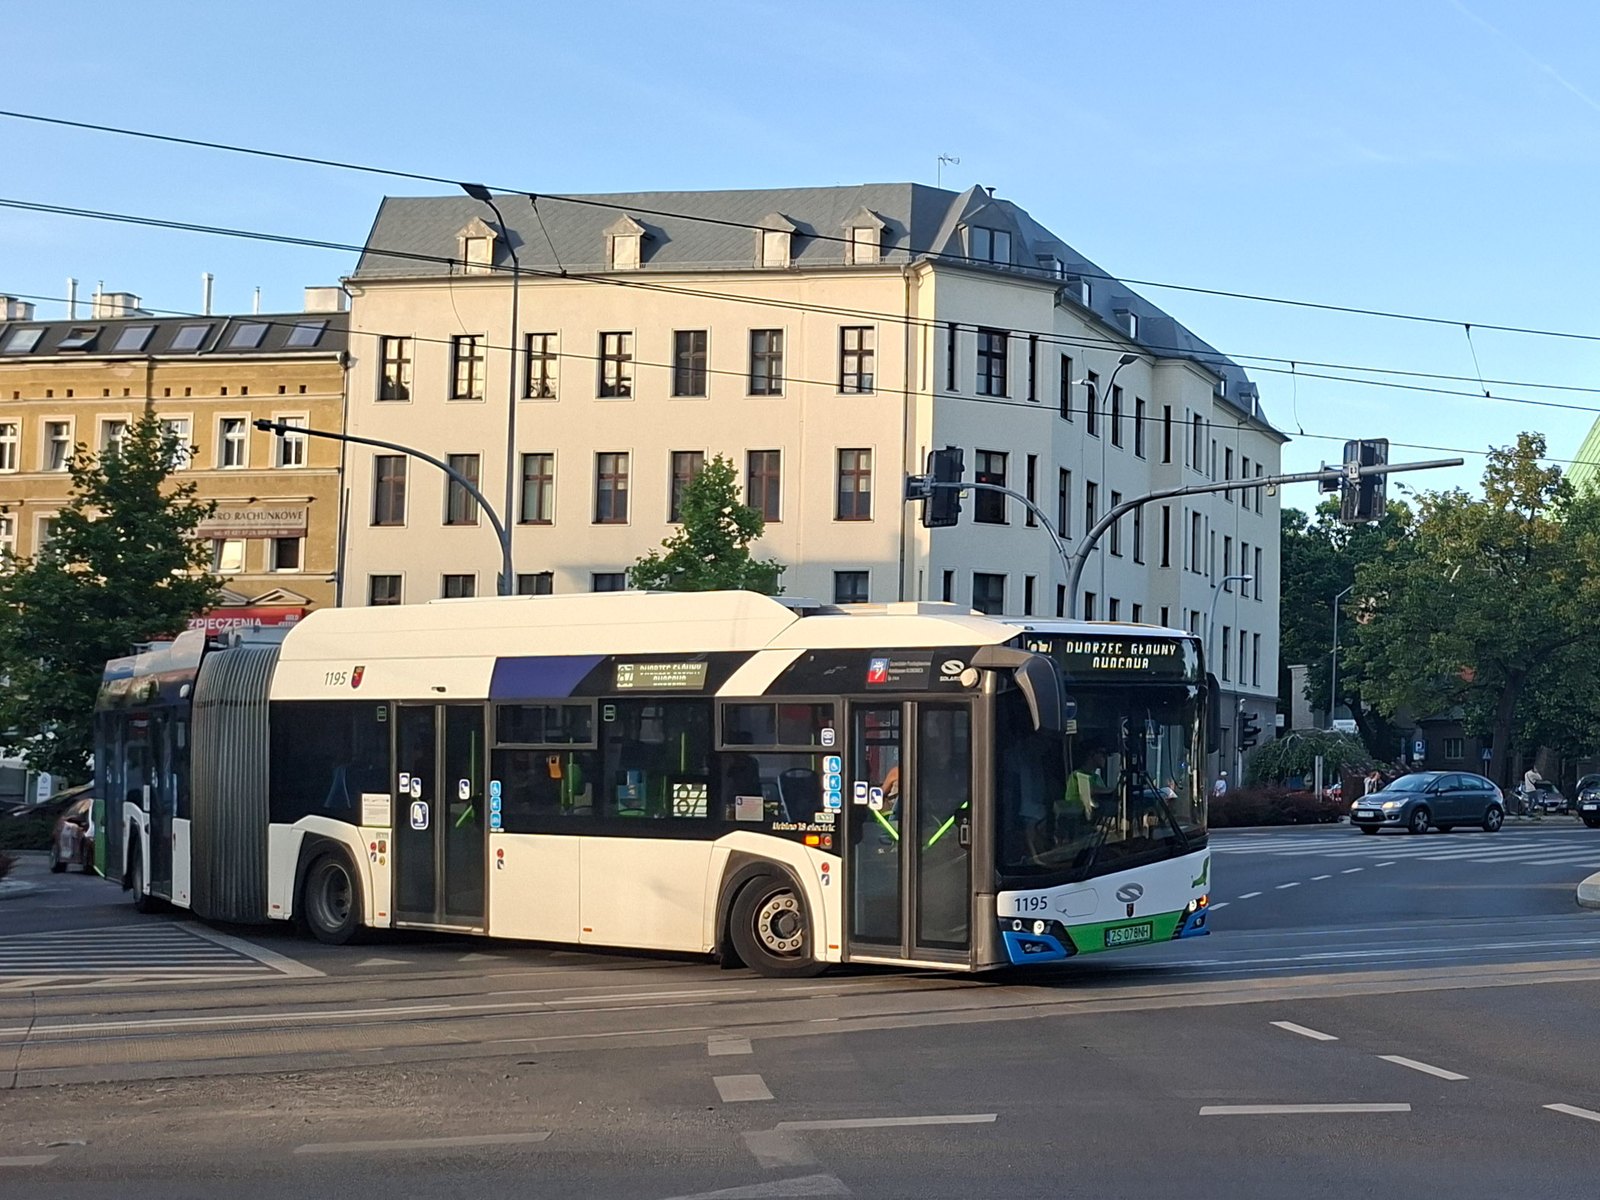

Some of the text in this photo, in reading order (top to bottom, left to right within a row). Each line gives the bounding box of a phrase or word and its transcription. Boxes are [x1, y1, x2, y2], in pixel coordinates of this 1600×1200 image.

[234, 511, 303, 520] RACHUNKOWE
[325, 672, 347, 685] 1195
[807, 823, 836, 832] electric
[1015, 897, 1047, 912] 1195
[1111, 926, 1149, 942] ZS 078NH
